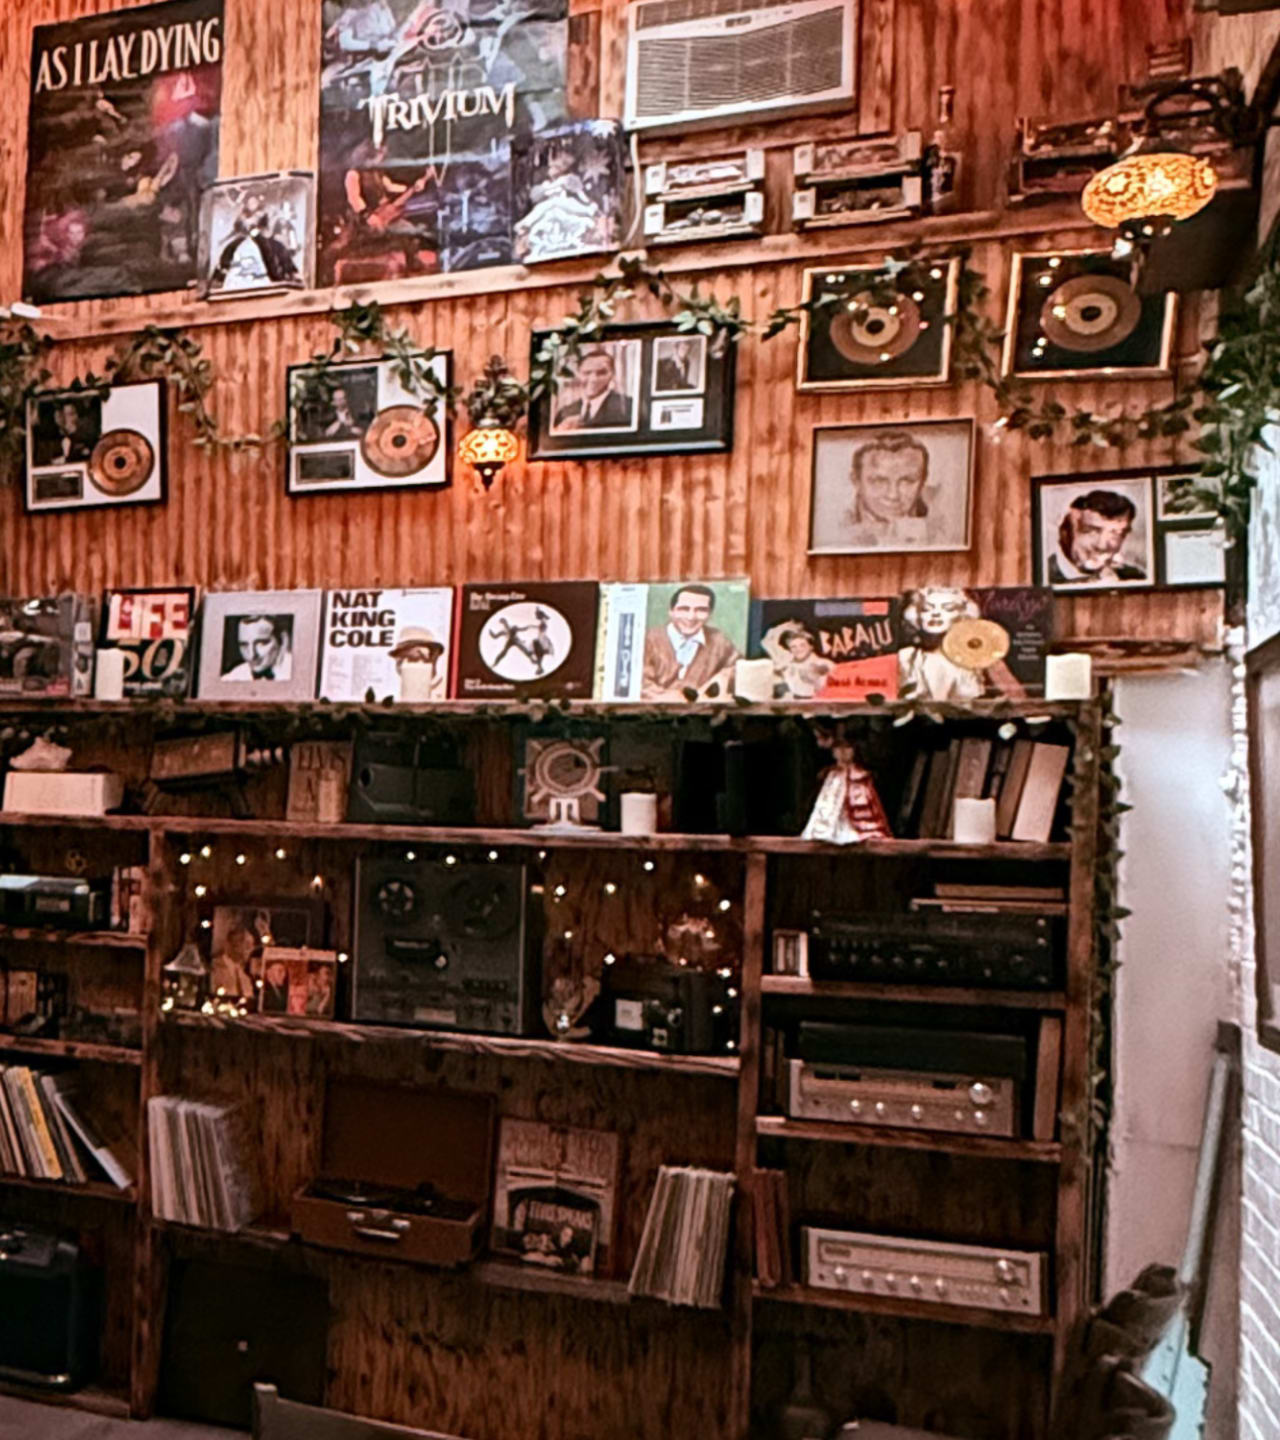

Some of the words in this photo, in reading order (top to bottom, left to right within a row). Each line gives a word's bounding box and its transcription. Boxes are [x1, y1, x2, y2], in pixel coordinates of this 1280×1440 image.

[35, 47, 67, 93] AS
[72, 43, 83, 86] I
[88, 32, 138, 84] LAY
[140, 17, 220, 74] DYING
[332, 591, 382, 609] NAT
[107, 594, 189, 640] LIFE
[331, 609, 395, 628] KING
[329, 630, 394, 648] COLE
[819, 618, 893, 658] BABALU
